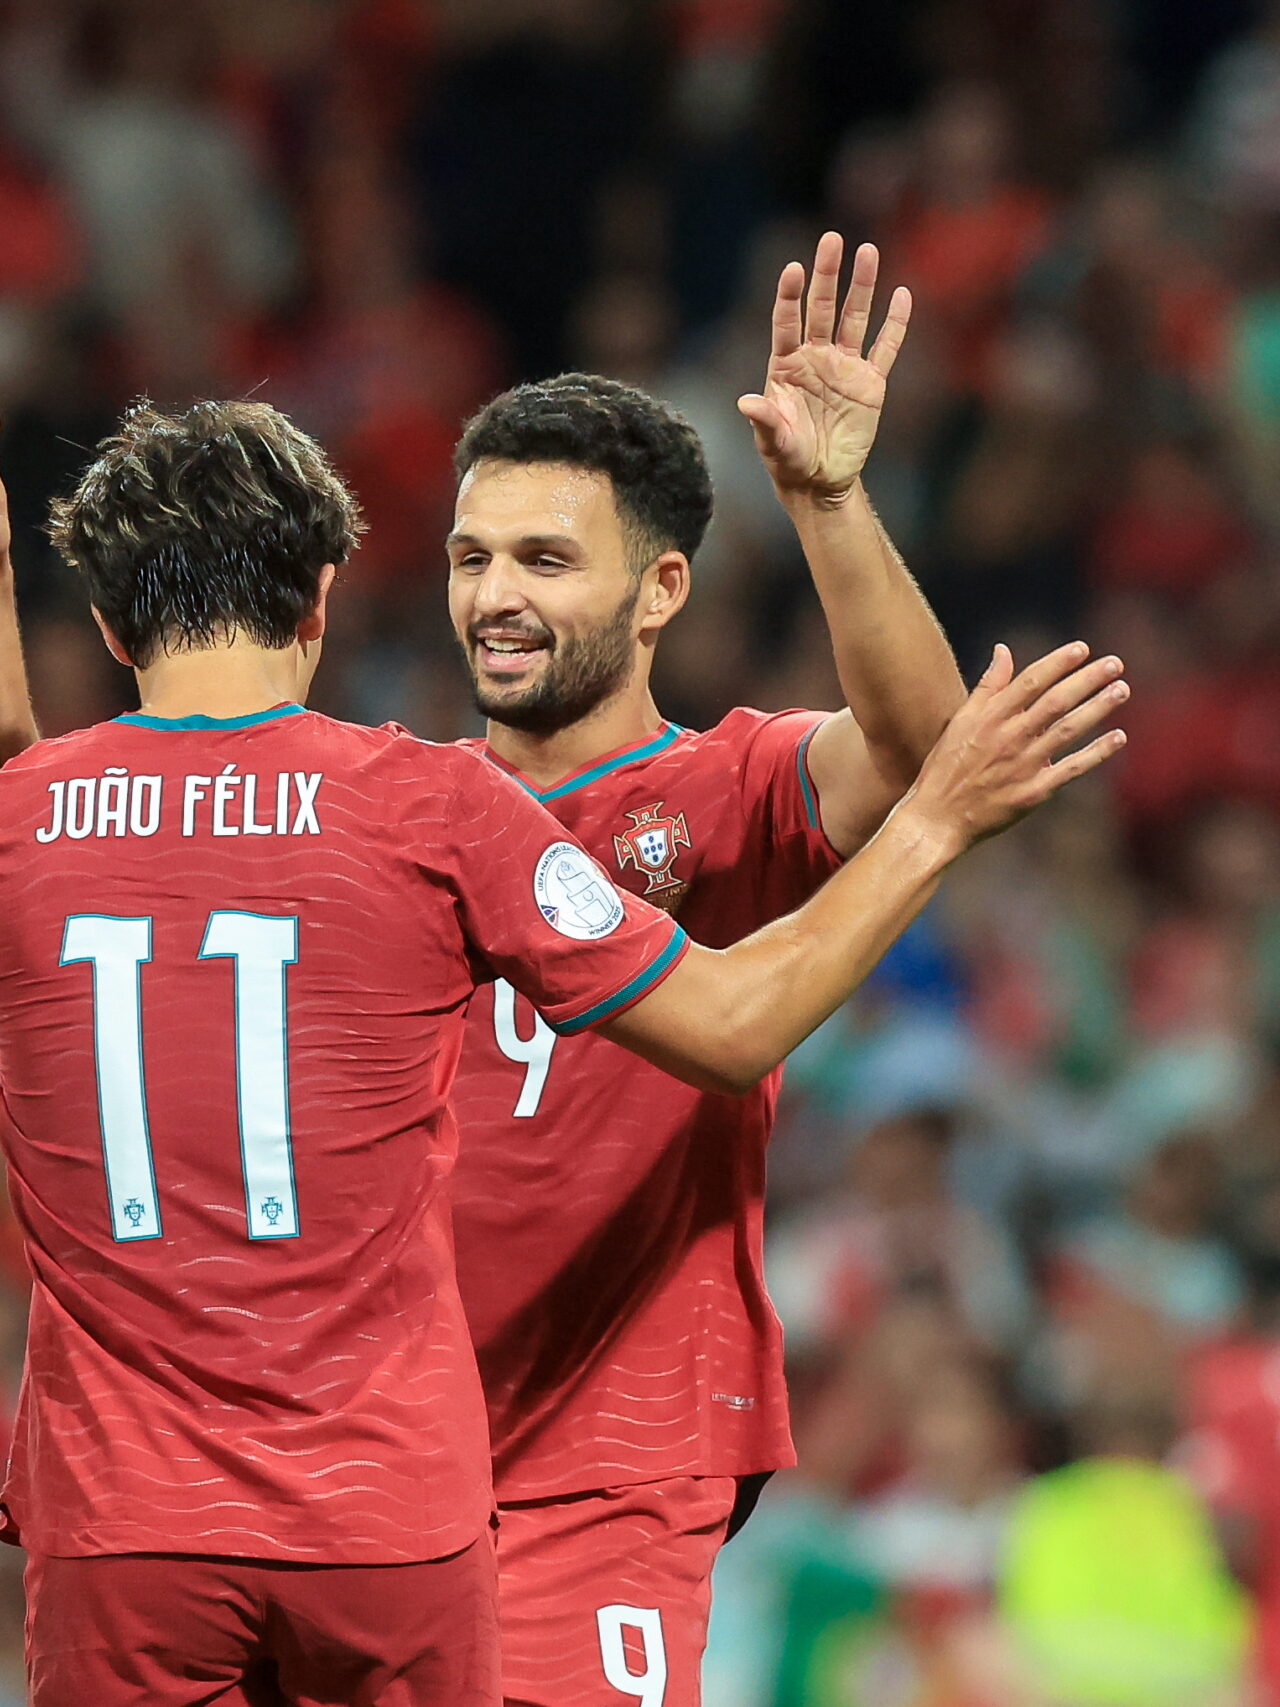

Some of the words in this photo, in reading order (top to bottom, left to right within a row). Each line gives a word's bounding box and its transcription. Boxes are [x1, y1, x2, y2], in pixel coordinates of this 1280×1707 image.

[35, 767, 163, 844] JOÃO
[182, 763, 324, 837] FÉLIX
[537, 872, 546, 892] UEFA
[588, 919, 614, 936] WINNER
[58, 910, 300, 1243] 11
[493, 976, 558, 1118] 9
[595, 1604, 669, 1707] 9
